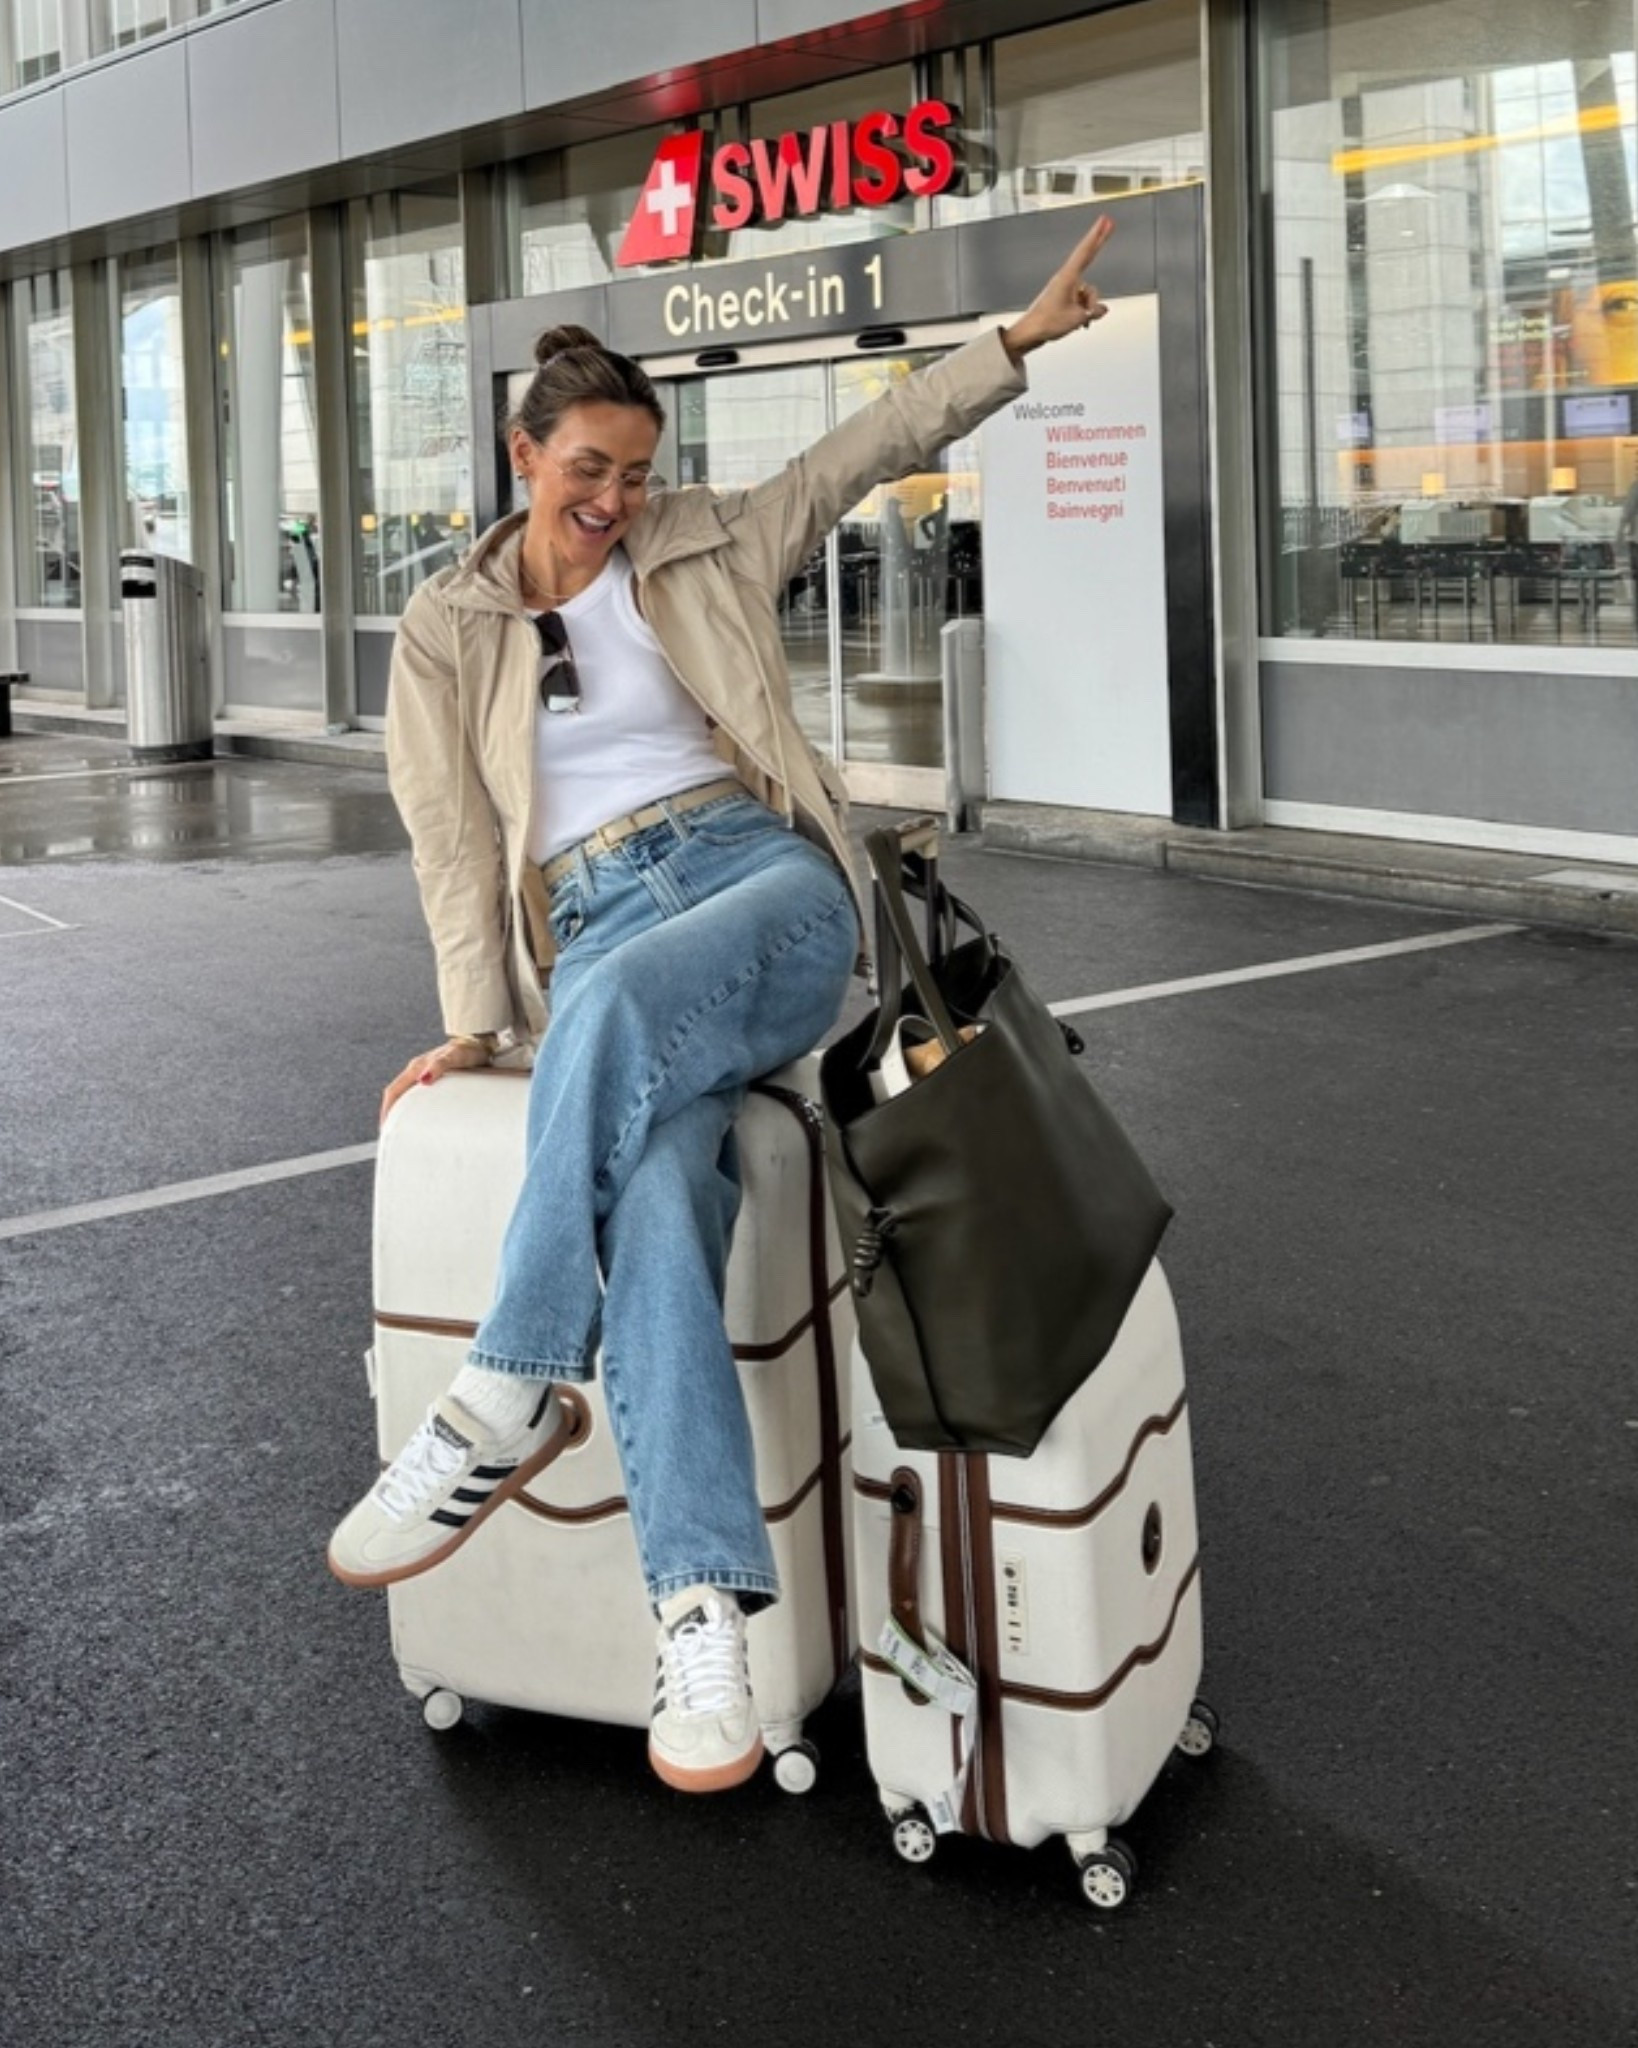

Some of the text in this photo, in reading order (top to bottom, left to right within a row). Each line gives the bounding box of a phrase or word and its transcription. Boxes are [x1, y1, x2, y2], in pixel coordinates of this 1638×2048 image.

[711, 100, 955, 231] SWISS
[664, 254, 883, 336] Check-in 1
[1013, 403, 1085, 420] Welcome
[1046, 424, 1146, 442] Willkommen
[1046, 451, 1128, 469] Bienvenue
[1046, 476, 1125, 494] Benvenuti
[1046, 500, 1124, 522] Bainvegni
